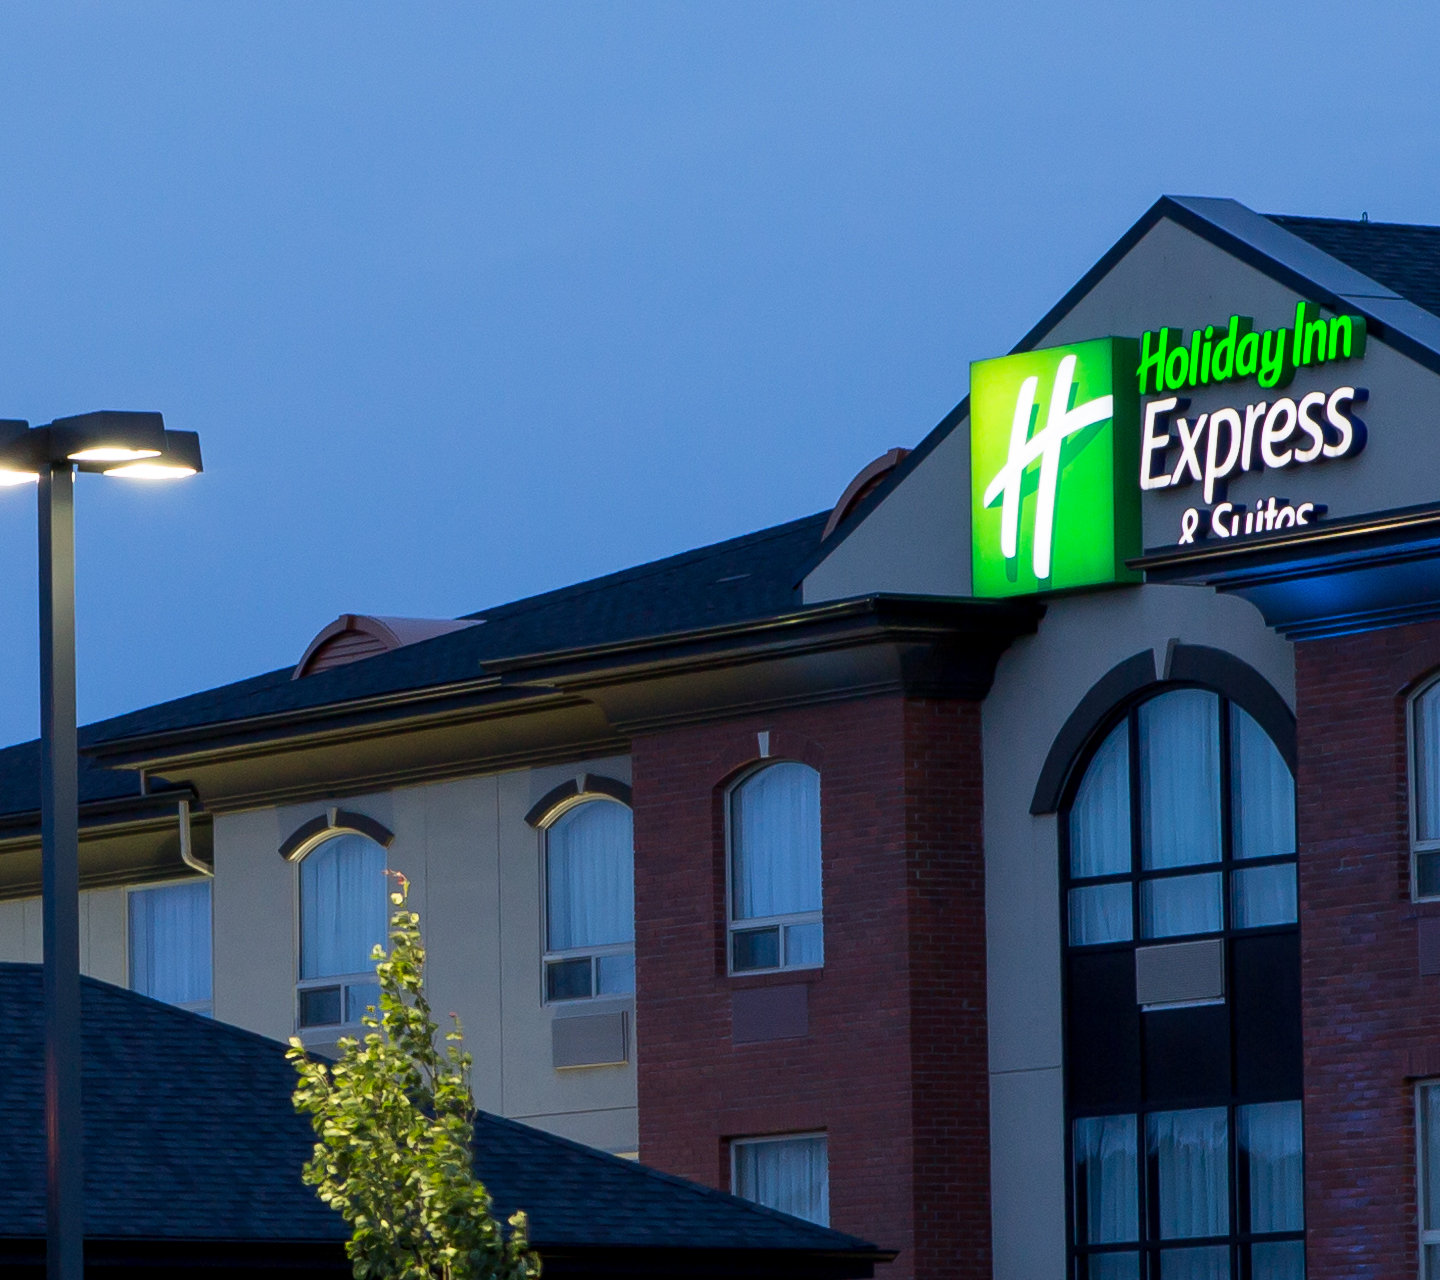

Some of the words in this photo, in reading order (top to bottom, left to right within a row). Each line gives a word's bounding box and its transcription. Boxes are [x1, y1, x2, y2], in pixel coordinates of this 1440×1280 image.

[1136, 315, 1286, 394] Holiday
[1293, 301, 1353, 368] Inn
[1139, 387, 1357, 502] Express
